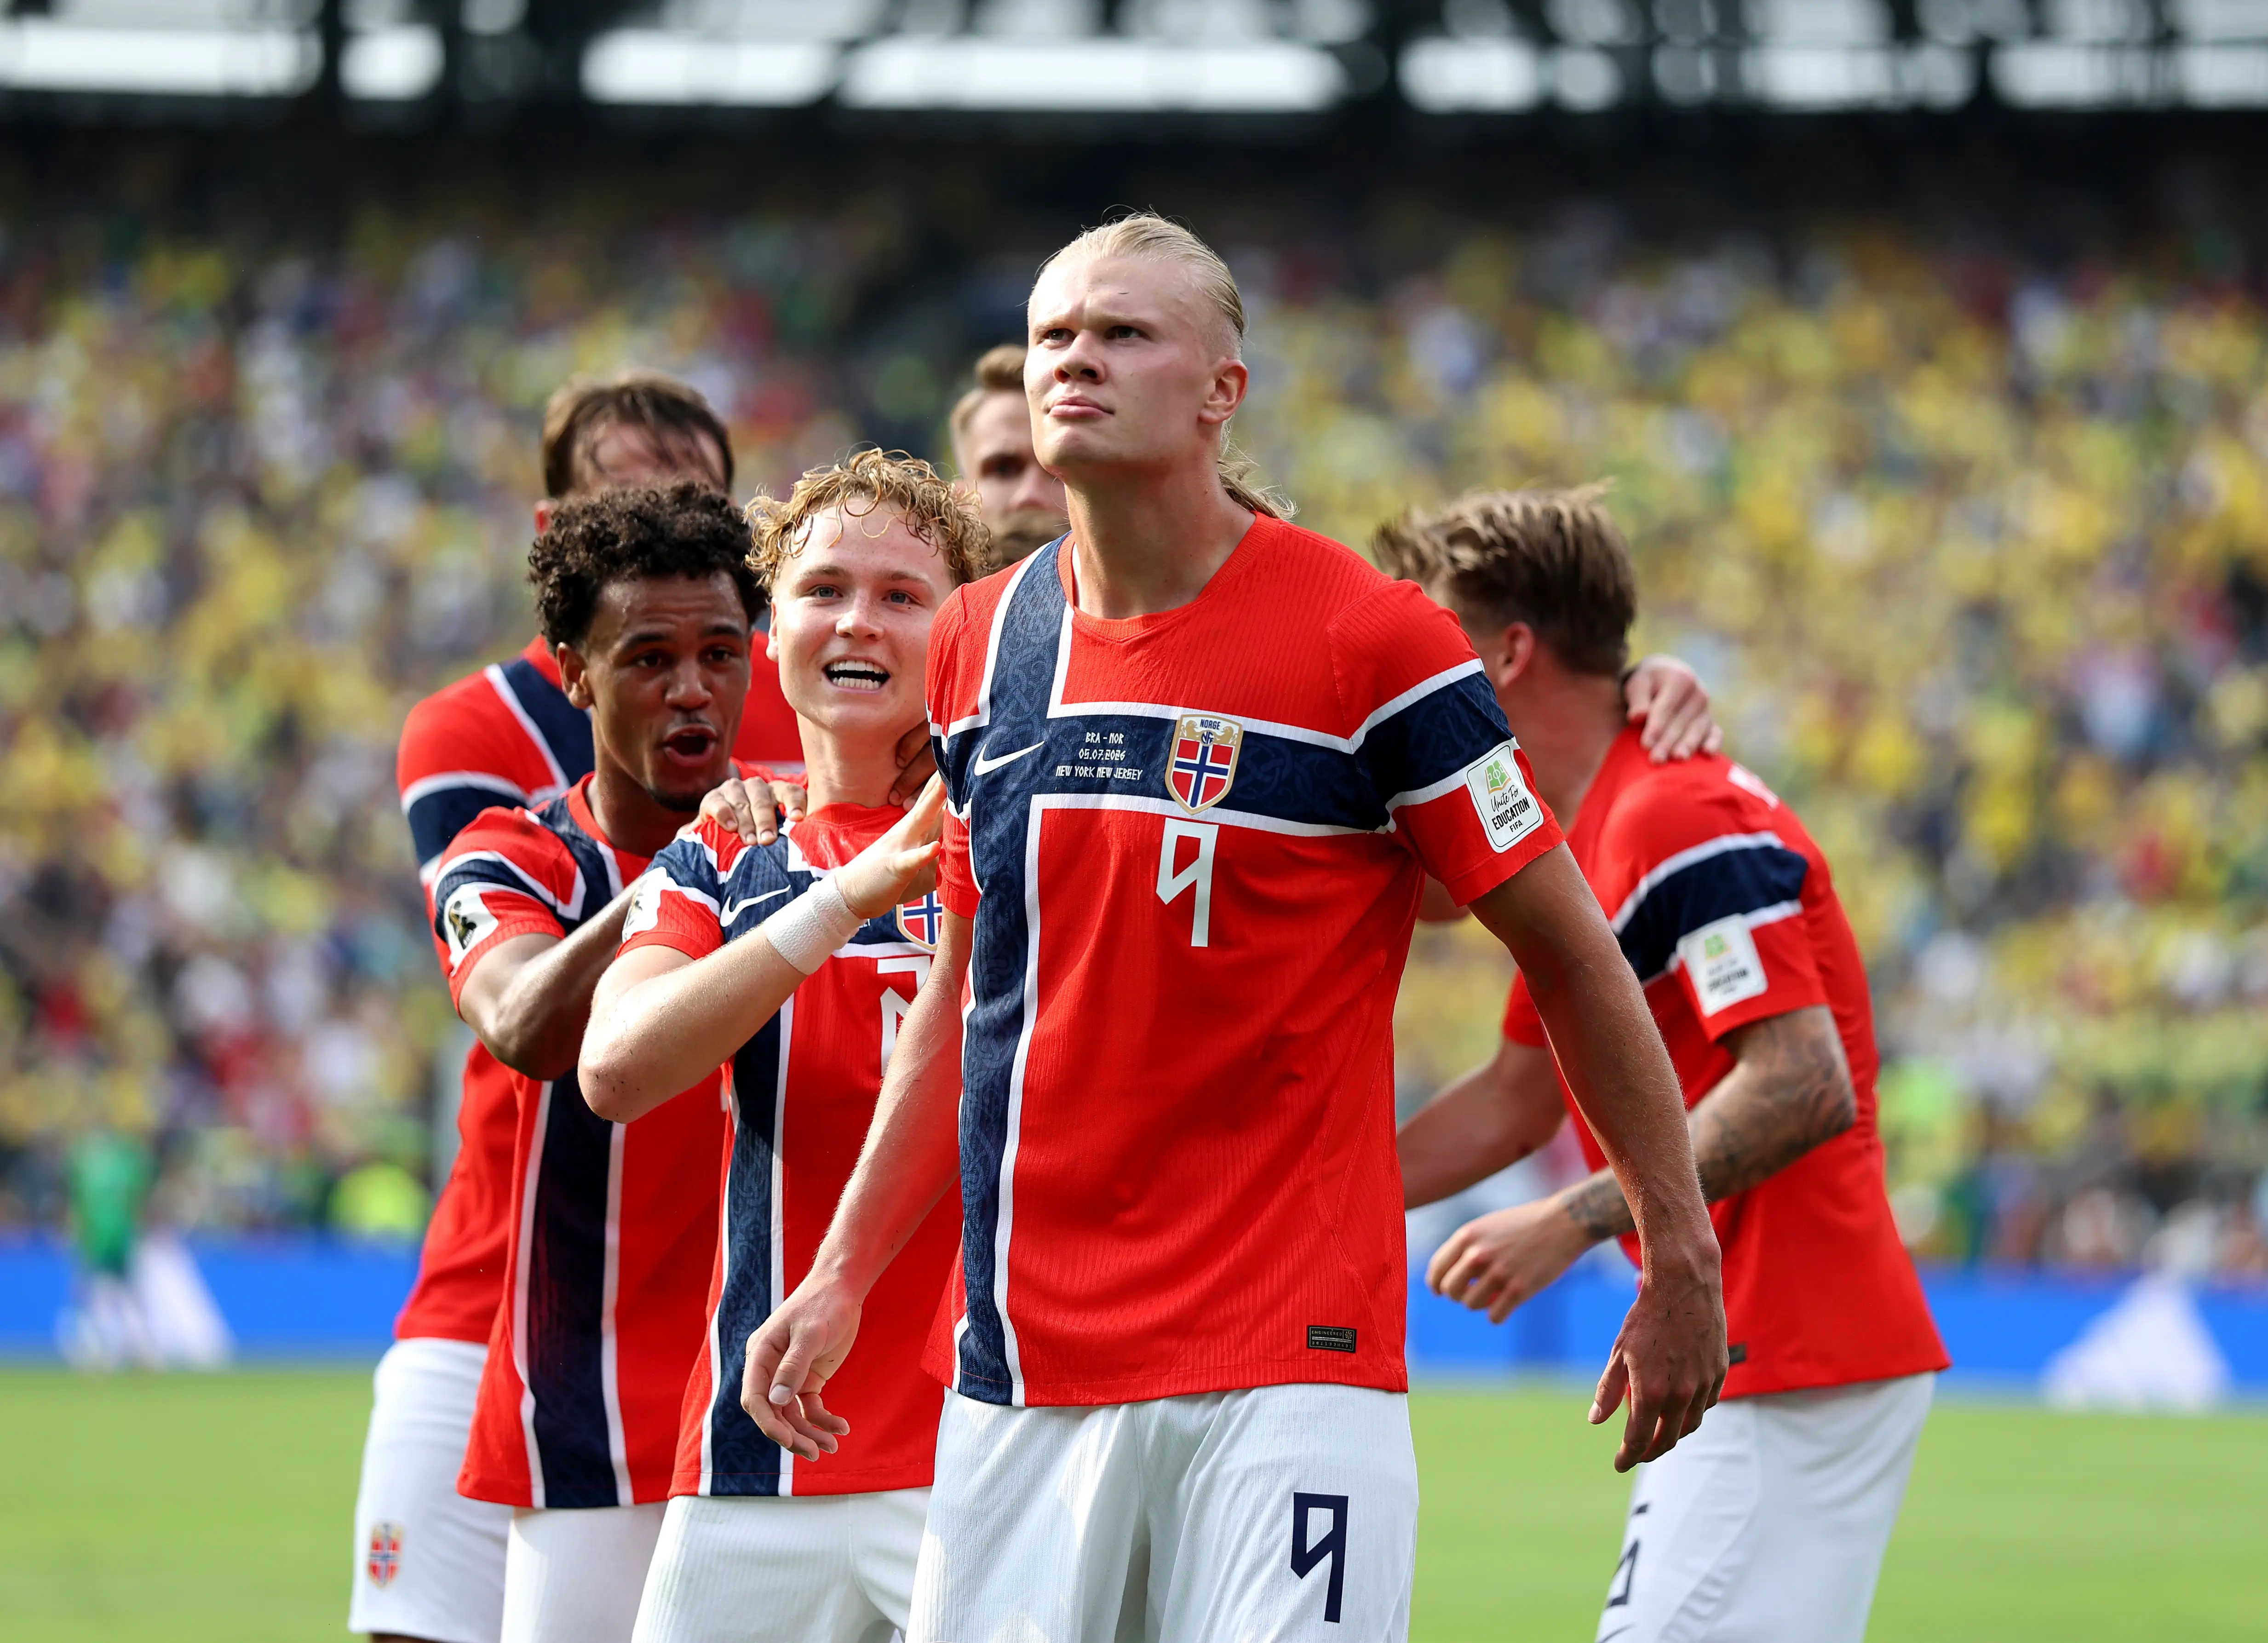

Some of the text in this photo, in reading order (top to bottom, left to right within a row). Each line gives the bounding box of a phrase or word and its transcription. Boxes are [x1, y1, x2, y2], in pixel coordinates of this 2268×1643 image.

[1200, 719, 1221, 730] NORGE
[1085, 732, 1100, 743] BRA
[1109, 733, 1124, 744] NOR
[1079, 748, 1126, 761] 05.07.2026
[1056, 765, 1143, 780] NEW YORK NEW JERSEY
[1491, 785, 1518, 812] Unite For
[1492, 797, 1530, 830] EDUCATION
[1509, 820, 1523, 833] FIFA
[1155, 817, 1219, 947] 9
[1291, 1492, 1349, 1623] 9
